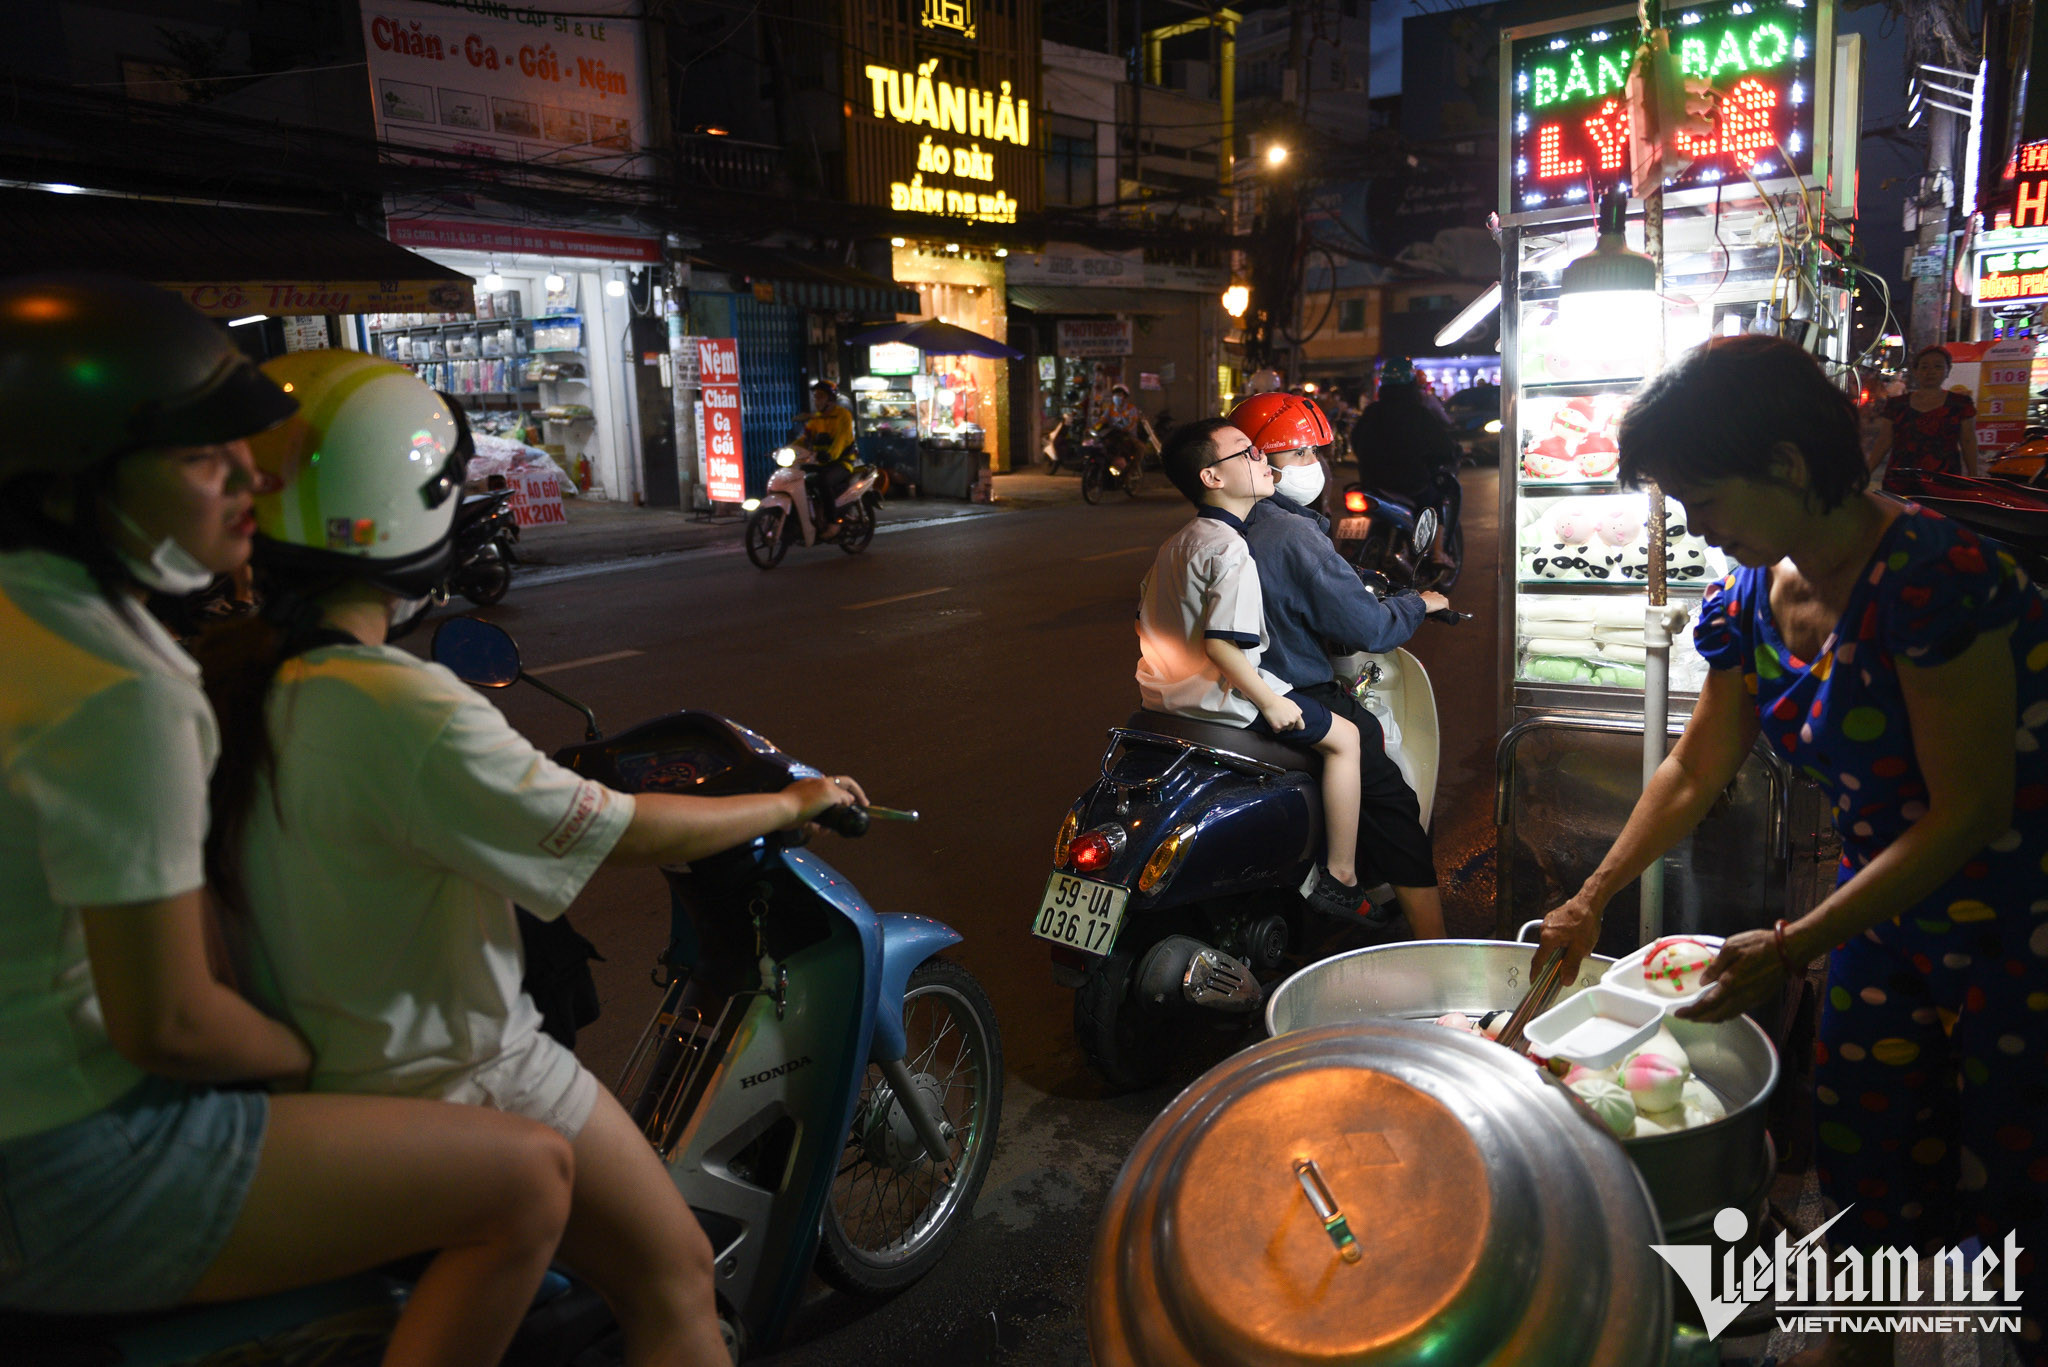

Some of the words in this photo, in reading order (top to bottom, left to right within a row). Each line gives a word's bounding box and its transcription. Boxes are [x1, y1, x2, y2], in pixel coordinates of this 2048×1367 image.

[371, 16, 444, 60] Chăn
[464, 34, 500, 71] Ga
[518, 44, 561, 83] Gối
[576, 56, 629, 100] Nệm
[1534, 48, 1632, 107] BÁN
[865, 58, 967, 135] TUẤN
[969, 80, 1029, 147] HẢI
[917, 134, 951, 175] ÁO
[953, 142, 994, 182] DÀI
[700, 342, 736, 382] Nệm
[704, 388, 737, 409] Chăn
[713, 412, 731, 432] Ga
[712, 432, 735, 455] Gối
[710, 457, 739, 483] Nệm
[1055, 876, 1114, 918] 59-UA
[1039, 906, 1112, 951] 036.17
[740, 1055, 814, 1090] HONDA
